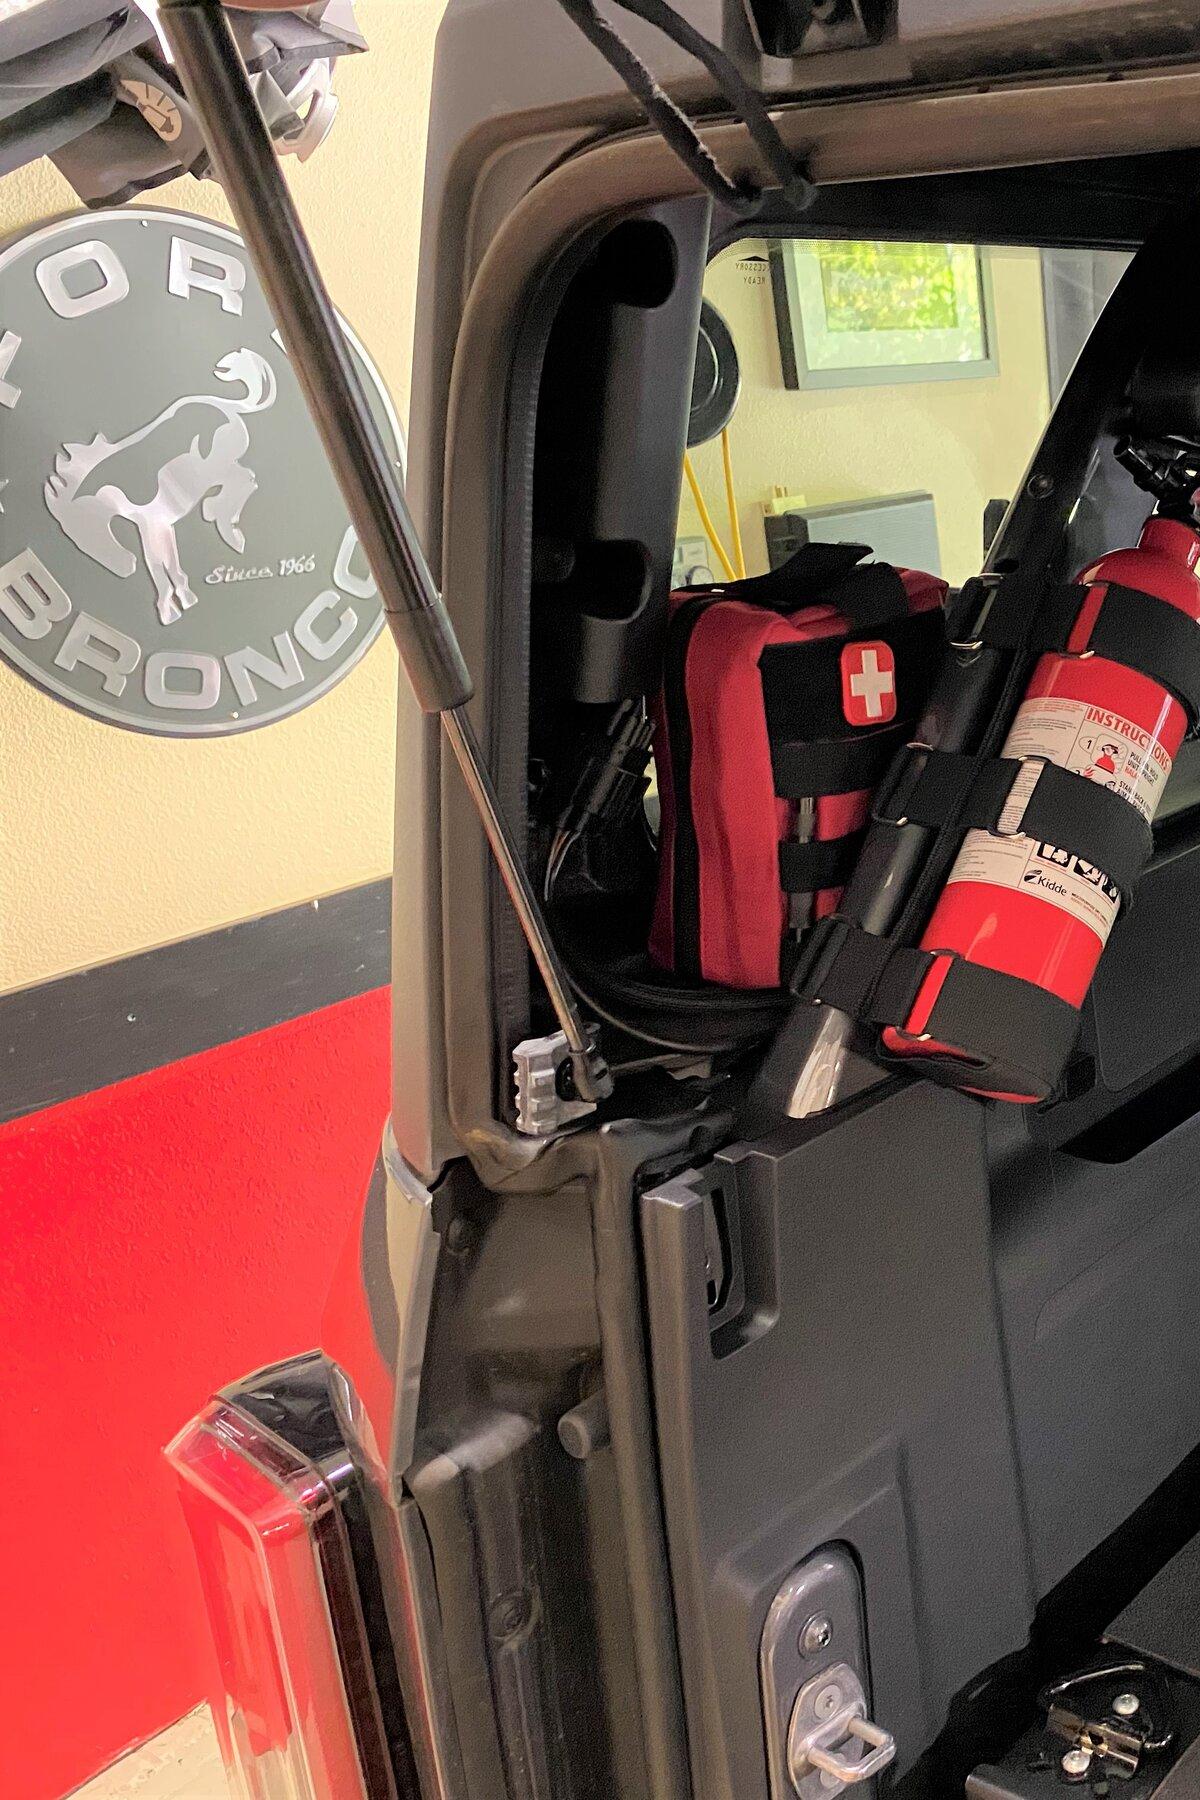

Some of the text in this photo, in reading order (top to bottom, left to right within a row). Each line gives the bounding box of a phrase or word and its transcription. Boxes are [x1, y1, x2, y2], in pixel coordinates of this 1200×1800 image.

[205, 553, 316, 584] Since 1966
[1087, 739, 1093, 750] 1
[1037, 875, 1067, 896] Kidde
